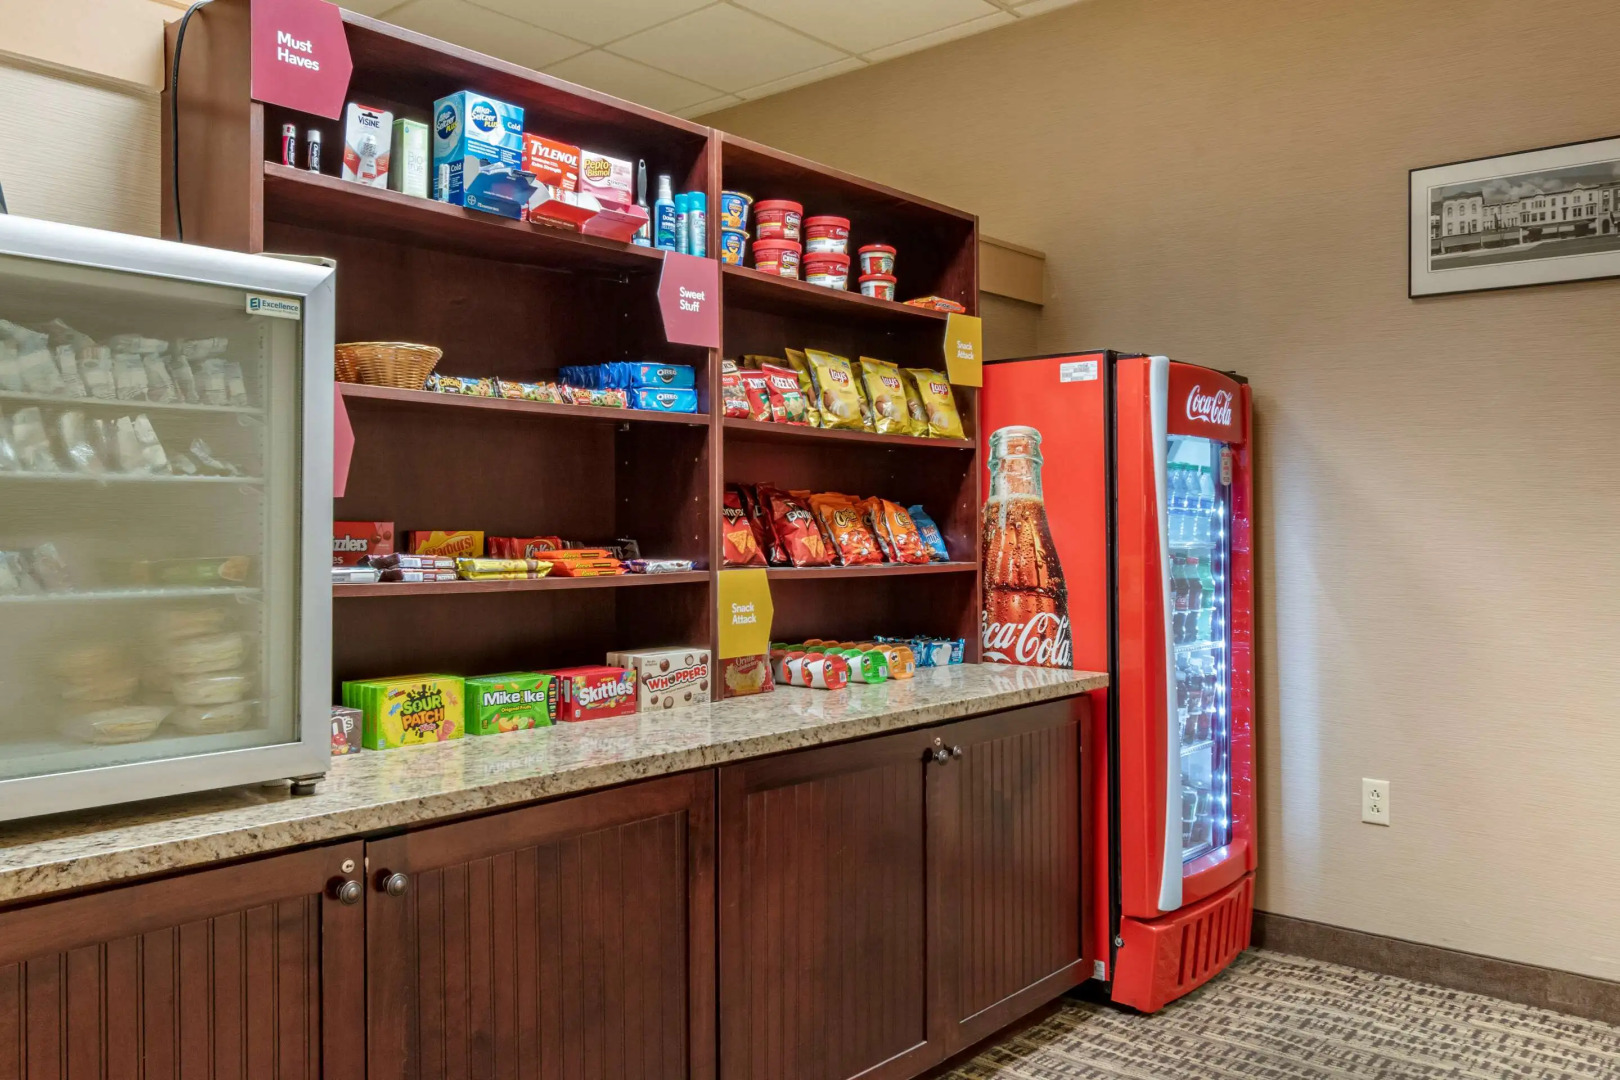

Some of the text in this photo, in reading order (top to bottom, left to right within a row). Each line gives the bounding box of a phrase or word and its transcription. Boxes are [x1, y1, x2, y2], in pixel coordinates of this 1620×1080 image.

[277, 31, 313, 53] Must
[277, 47, 320, 71] Haves
[507, 121, 521, 132] Cold
[530, 140, 578, 166] TYLENOL
[450, 162, 462, 172] Cold
[587, 168, 611, 178] Bismol
[679, 286, 706, 302] Sweet
[262, 299, 299, 312] Excellence
[679, 299, 700, 313] Stuff
[956, 340, 973, 351] Snack
[956, 350, 975, 360] Attack
[656, 367, 678, 377] OREO
[656, 392, 679, 402] OREO
[1186, 384, 1233, 426] Coca-Cola
[722, 507, 745, 517] oritos
[731, 602, 755, 613] Snack
[731, 612, 757, 625] Attack
[648, 664, 708, 692] WHOPPERS
[484, 690, 521, 707] Mike
[524, 689, 545, 702] Ike
[578, 681, 634, 706] Skittles
[402, 694, 443, 715] SOUR
[401, 706, 445, 732] PATCH
